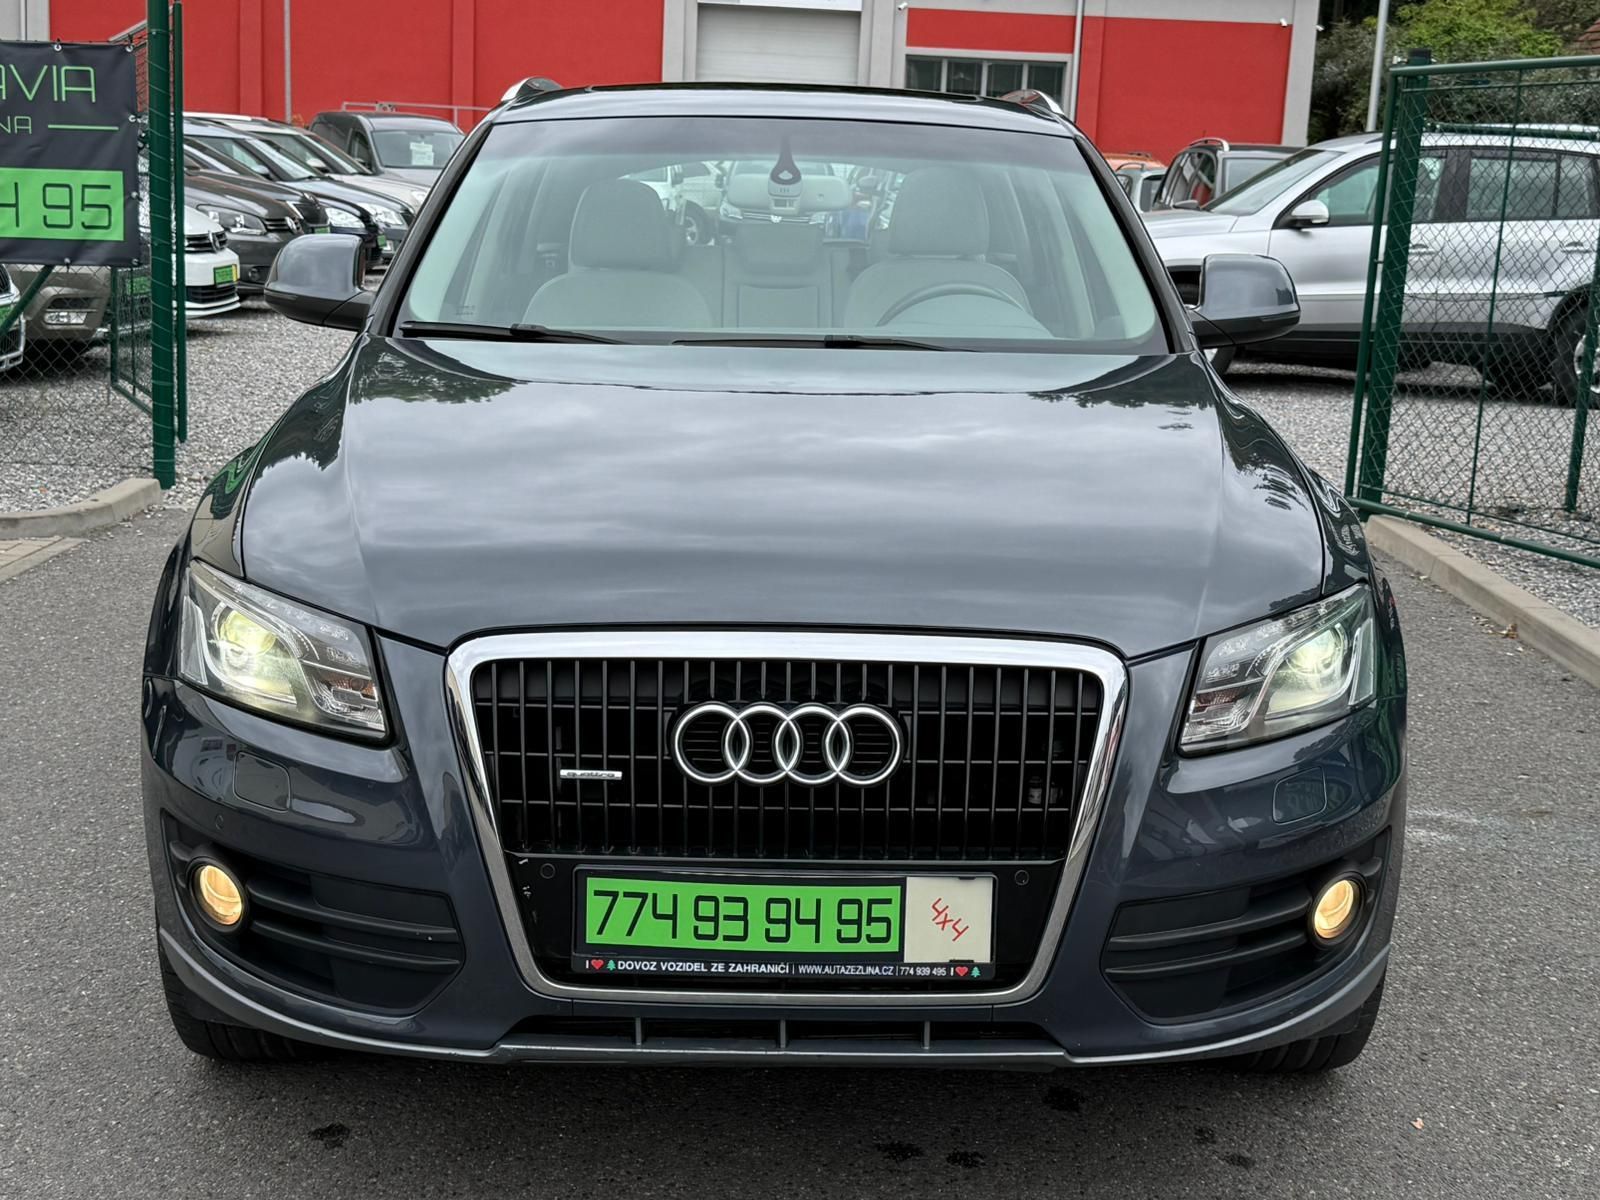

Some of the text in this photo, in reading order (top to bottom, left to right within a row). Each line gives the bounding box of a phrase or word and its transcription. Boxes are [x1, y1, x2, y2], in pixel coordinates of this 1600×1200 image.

[42, 182, 112, 230] 95
[593, 889, 892, 944] 774 93 94 95
[617, 960, 657, 971] DOVOZ
[660, 961, 708, 972] VOZIDEL
[710, 962, 726, 973] ZE
[728, 962, 790, 974] ZAHRANIČÍ
[798, 965, 894, 975] WWW.AUTAZEZLINA.CZ
[900, 966, 915, 976] 774
[916, 967, 931, 976] 939
[932, 967, 947, 977] 495
